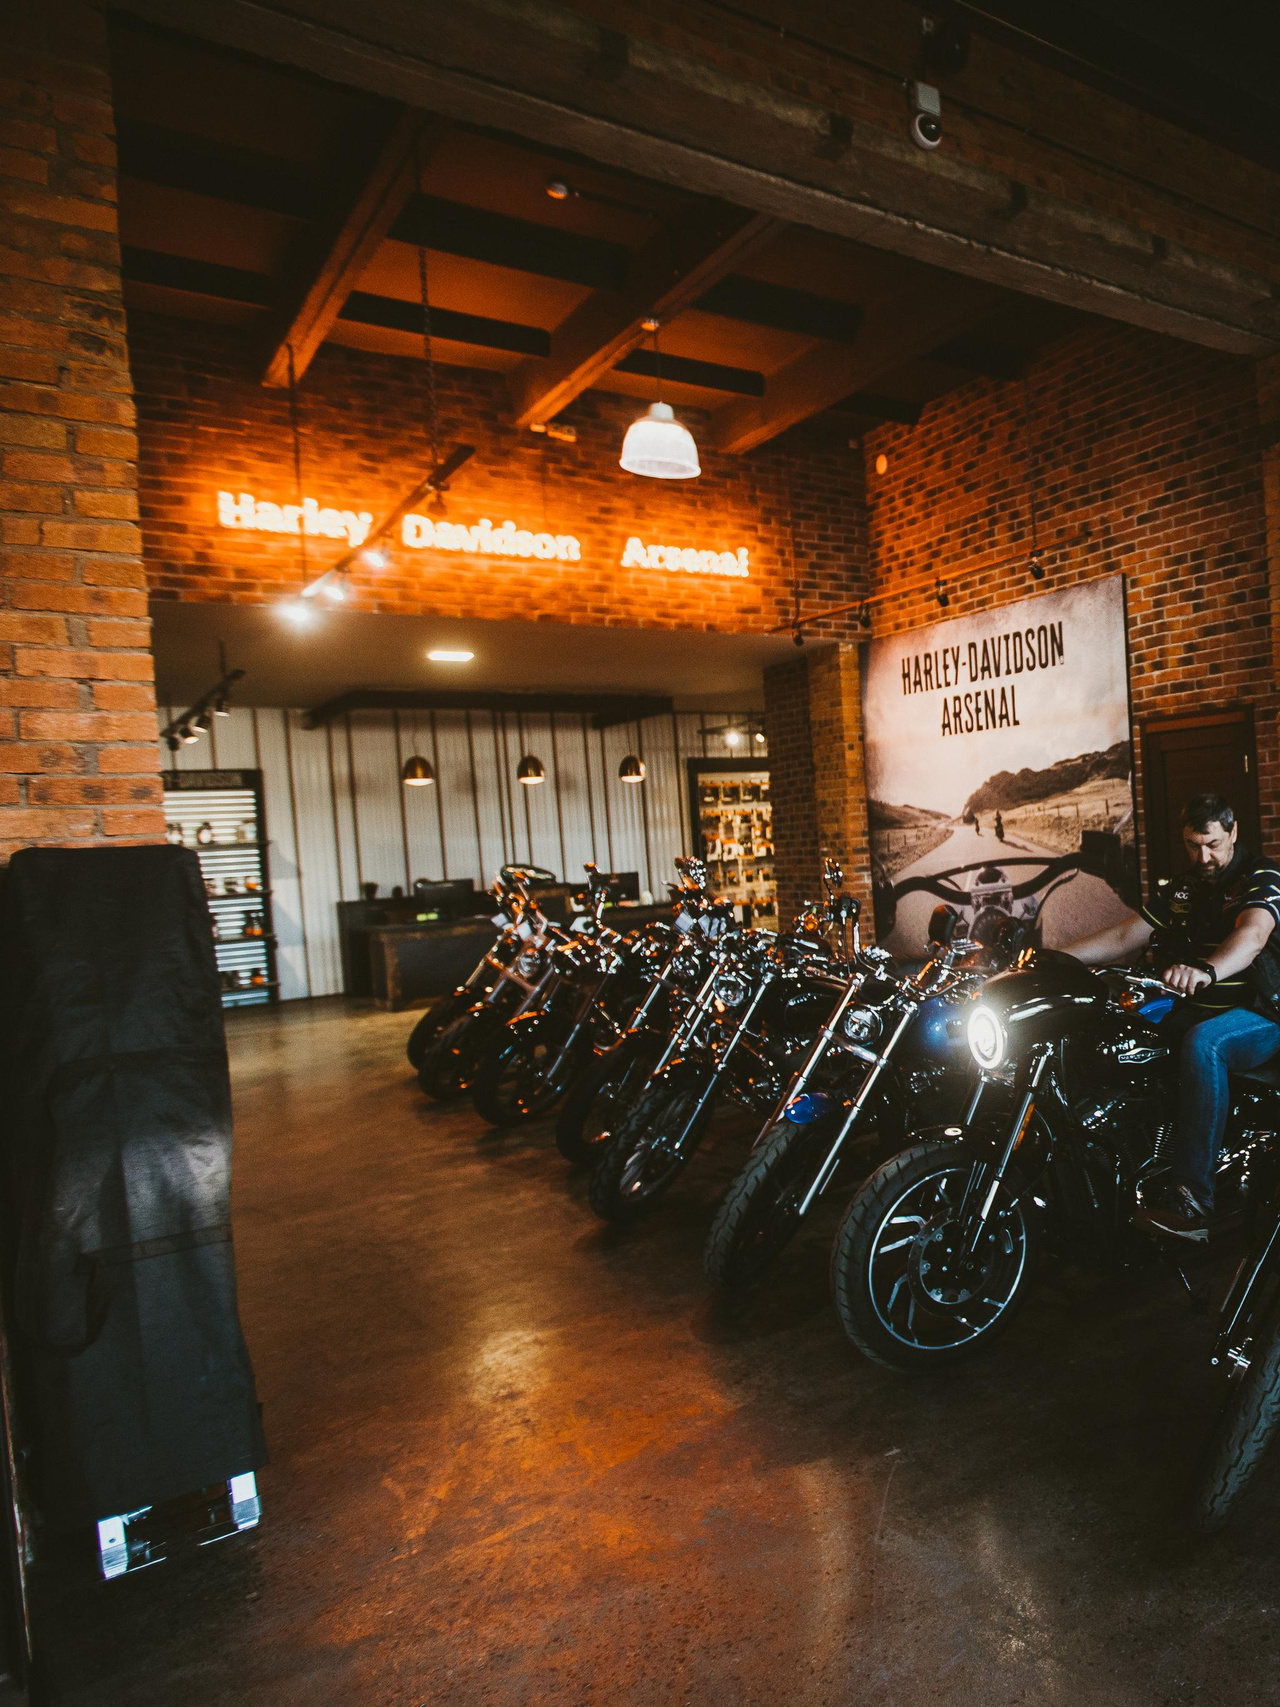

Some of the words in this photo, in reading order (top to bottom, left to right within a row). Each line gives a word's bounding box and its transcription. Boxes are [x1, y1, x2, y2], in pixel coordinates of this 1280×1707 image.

[217, 490, 373, 548] Harley
[402, 513, 581, 562] Davidson
[621, 536, 749, 578] Arsenal
[901, 621, 1065, 696] HARLEY-DAVIDSON
[941, 685, 1020, 736] ARSENAL
